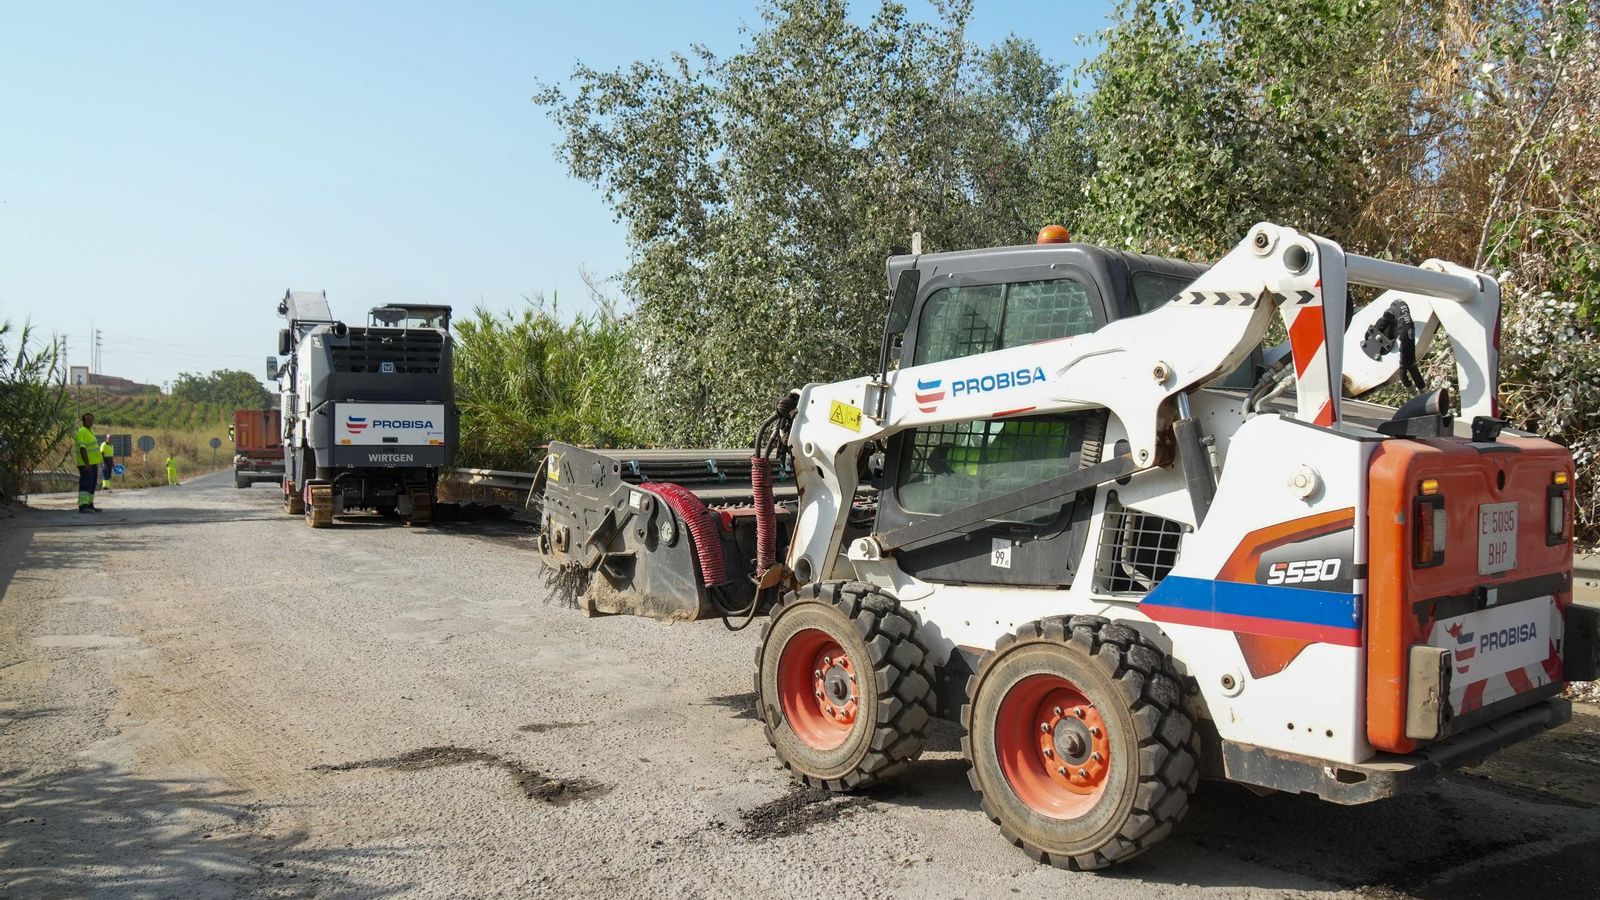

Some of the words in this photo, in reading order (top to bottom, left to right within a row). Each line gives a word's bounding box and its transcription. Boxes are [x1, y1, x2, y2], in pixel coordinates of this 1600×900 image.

[952, 366, 1047, 397] PROBISA
[372, 420, 434, 429] PROBISA
[368, 453, 414, 462] WIRTGEN
[1482, 512, 1488, 535] E
[1492, 509, 1515, 533] 5095
[995, 550, 1005, 565] 99
[1488, 541, 1508, 566] BHP
[1266, 558, 1342, 585] S530
[1480, 621, 1538, 654] PROBISA
